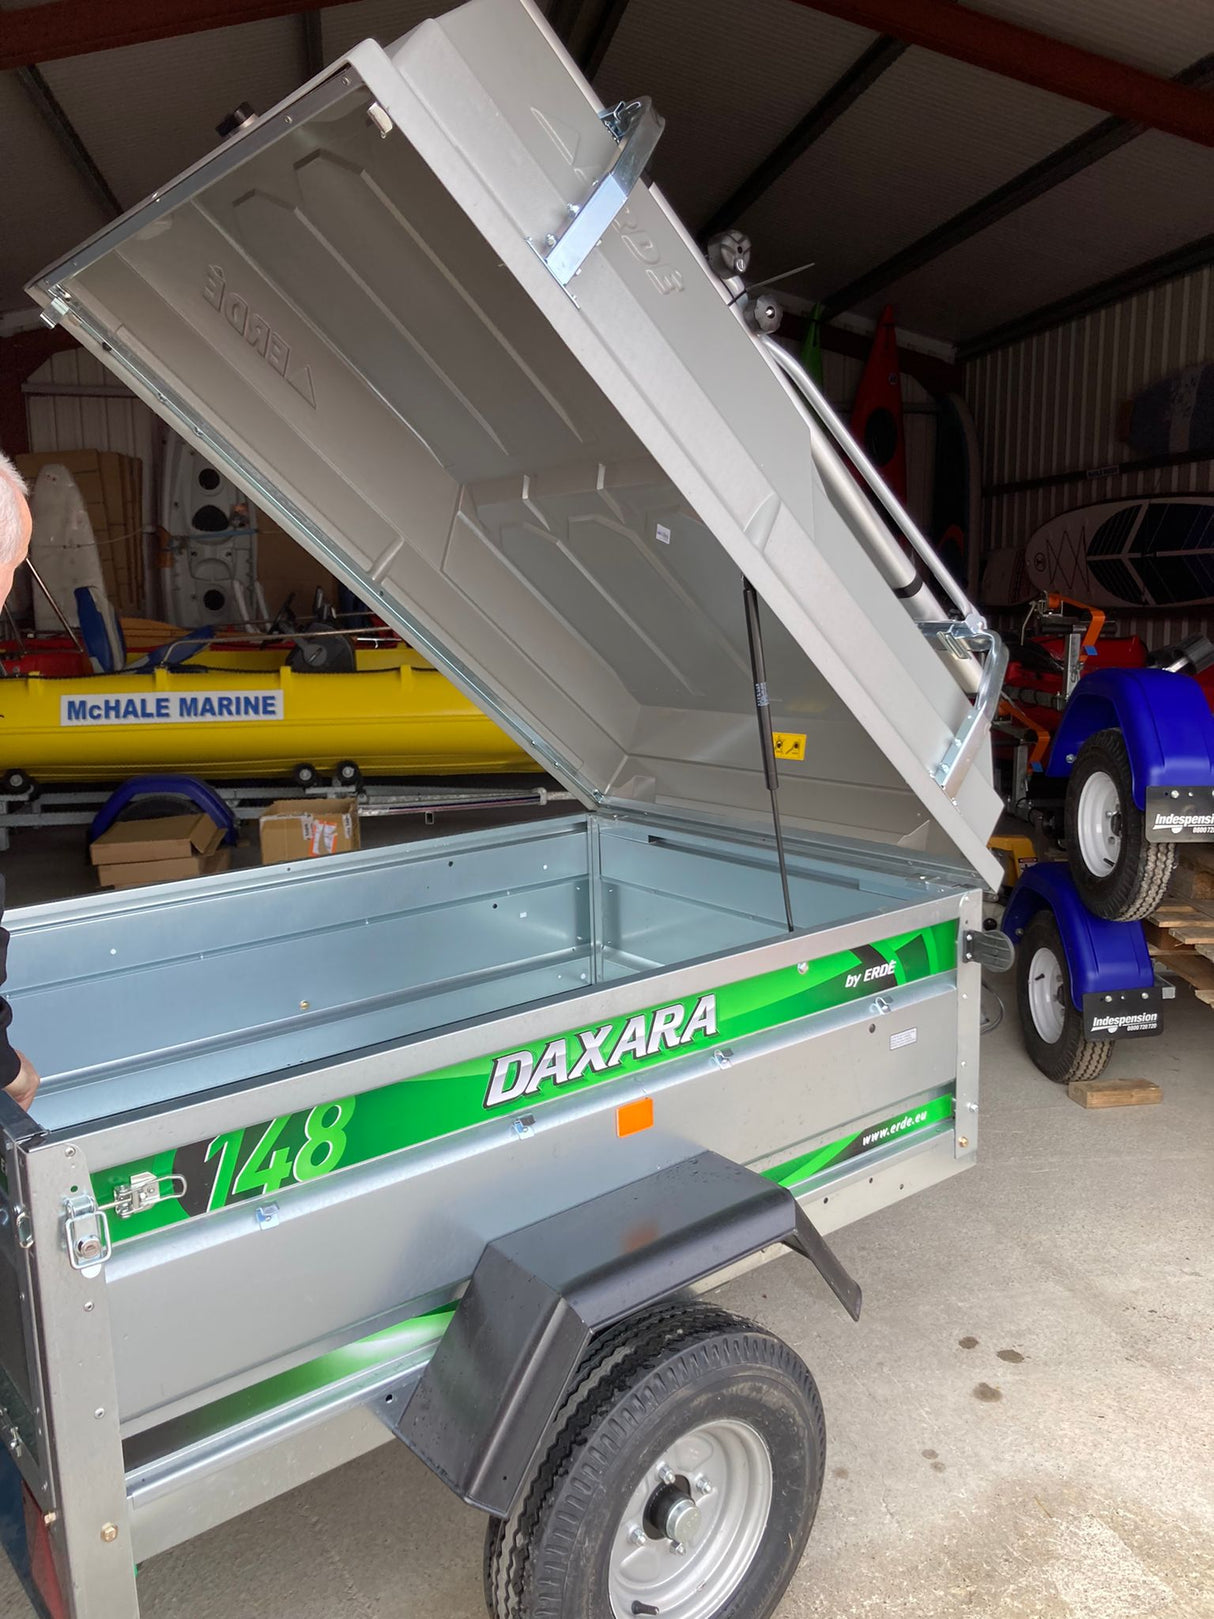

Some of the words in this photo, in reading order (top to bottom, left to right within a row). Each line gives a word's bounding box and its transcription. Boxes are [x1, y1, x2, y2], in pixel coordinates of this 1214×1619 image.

[67, 698, 170, 721] McHALE
[179, 696, 276, 718] MARINE
[845, 974, 861, 988] by
[1093, 1012, 1158, 1027] Indespension
[483, 993, 720, 1109] DAXARA
[862, 1110, 928, 1146] www.erde.eu
[204, 1094, 356, 1213] 148
